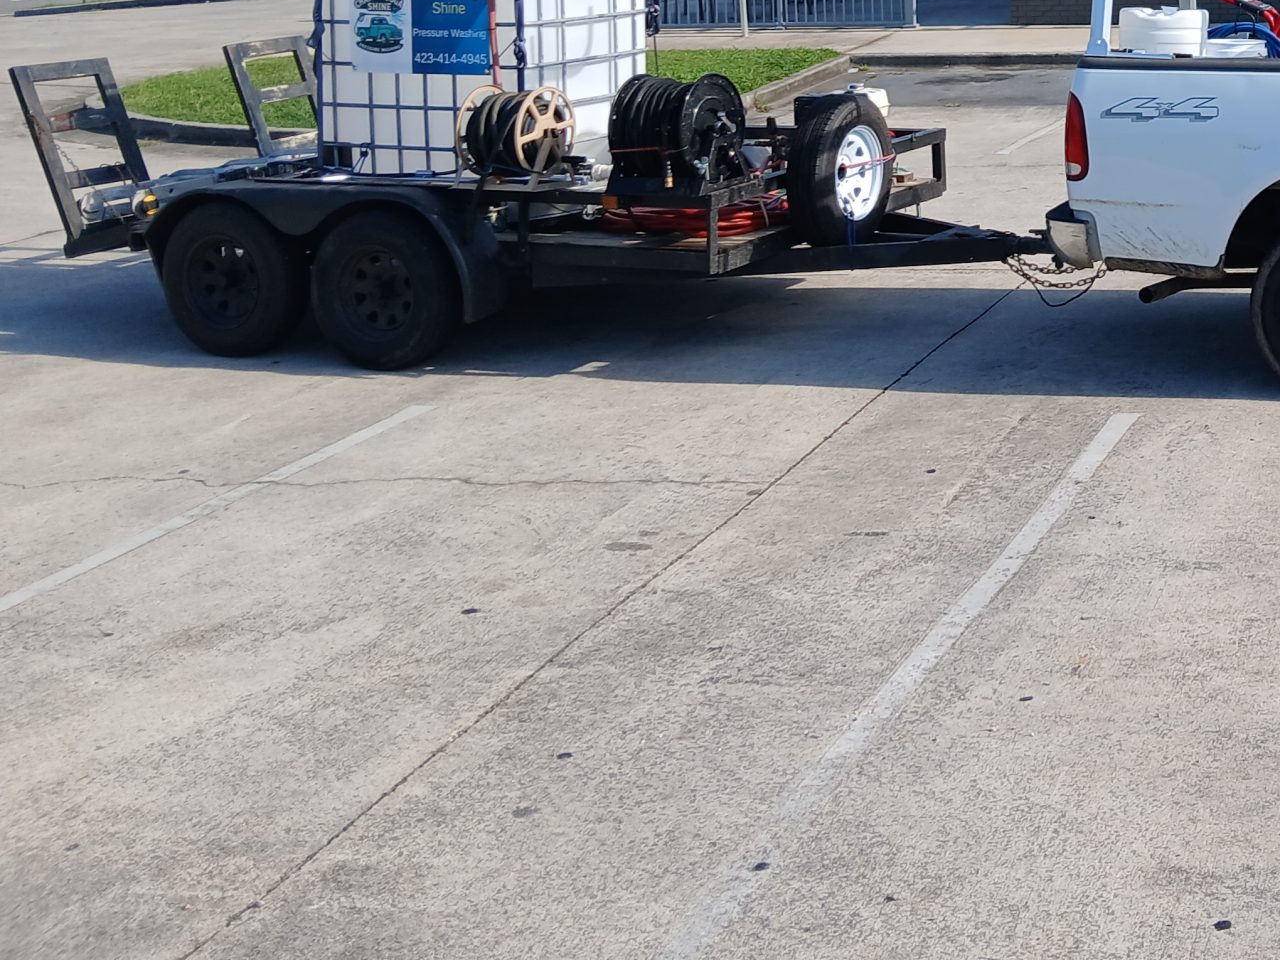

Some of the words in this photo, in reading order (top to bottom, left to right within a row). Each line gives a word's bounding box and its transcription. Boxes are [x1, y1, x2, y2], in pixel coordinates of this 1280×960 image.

[367, 2, 392, 11] SHINE
[432, 2, 466, 14] Shine
[412, 28, 449, 38] Pressure
[450, 29, 487, 40] Washing
[414, 53, 487, 65] 423-414-4945
